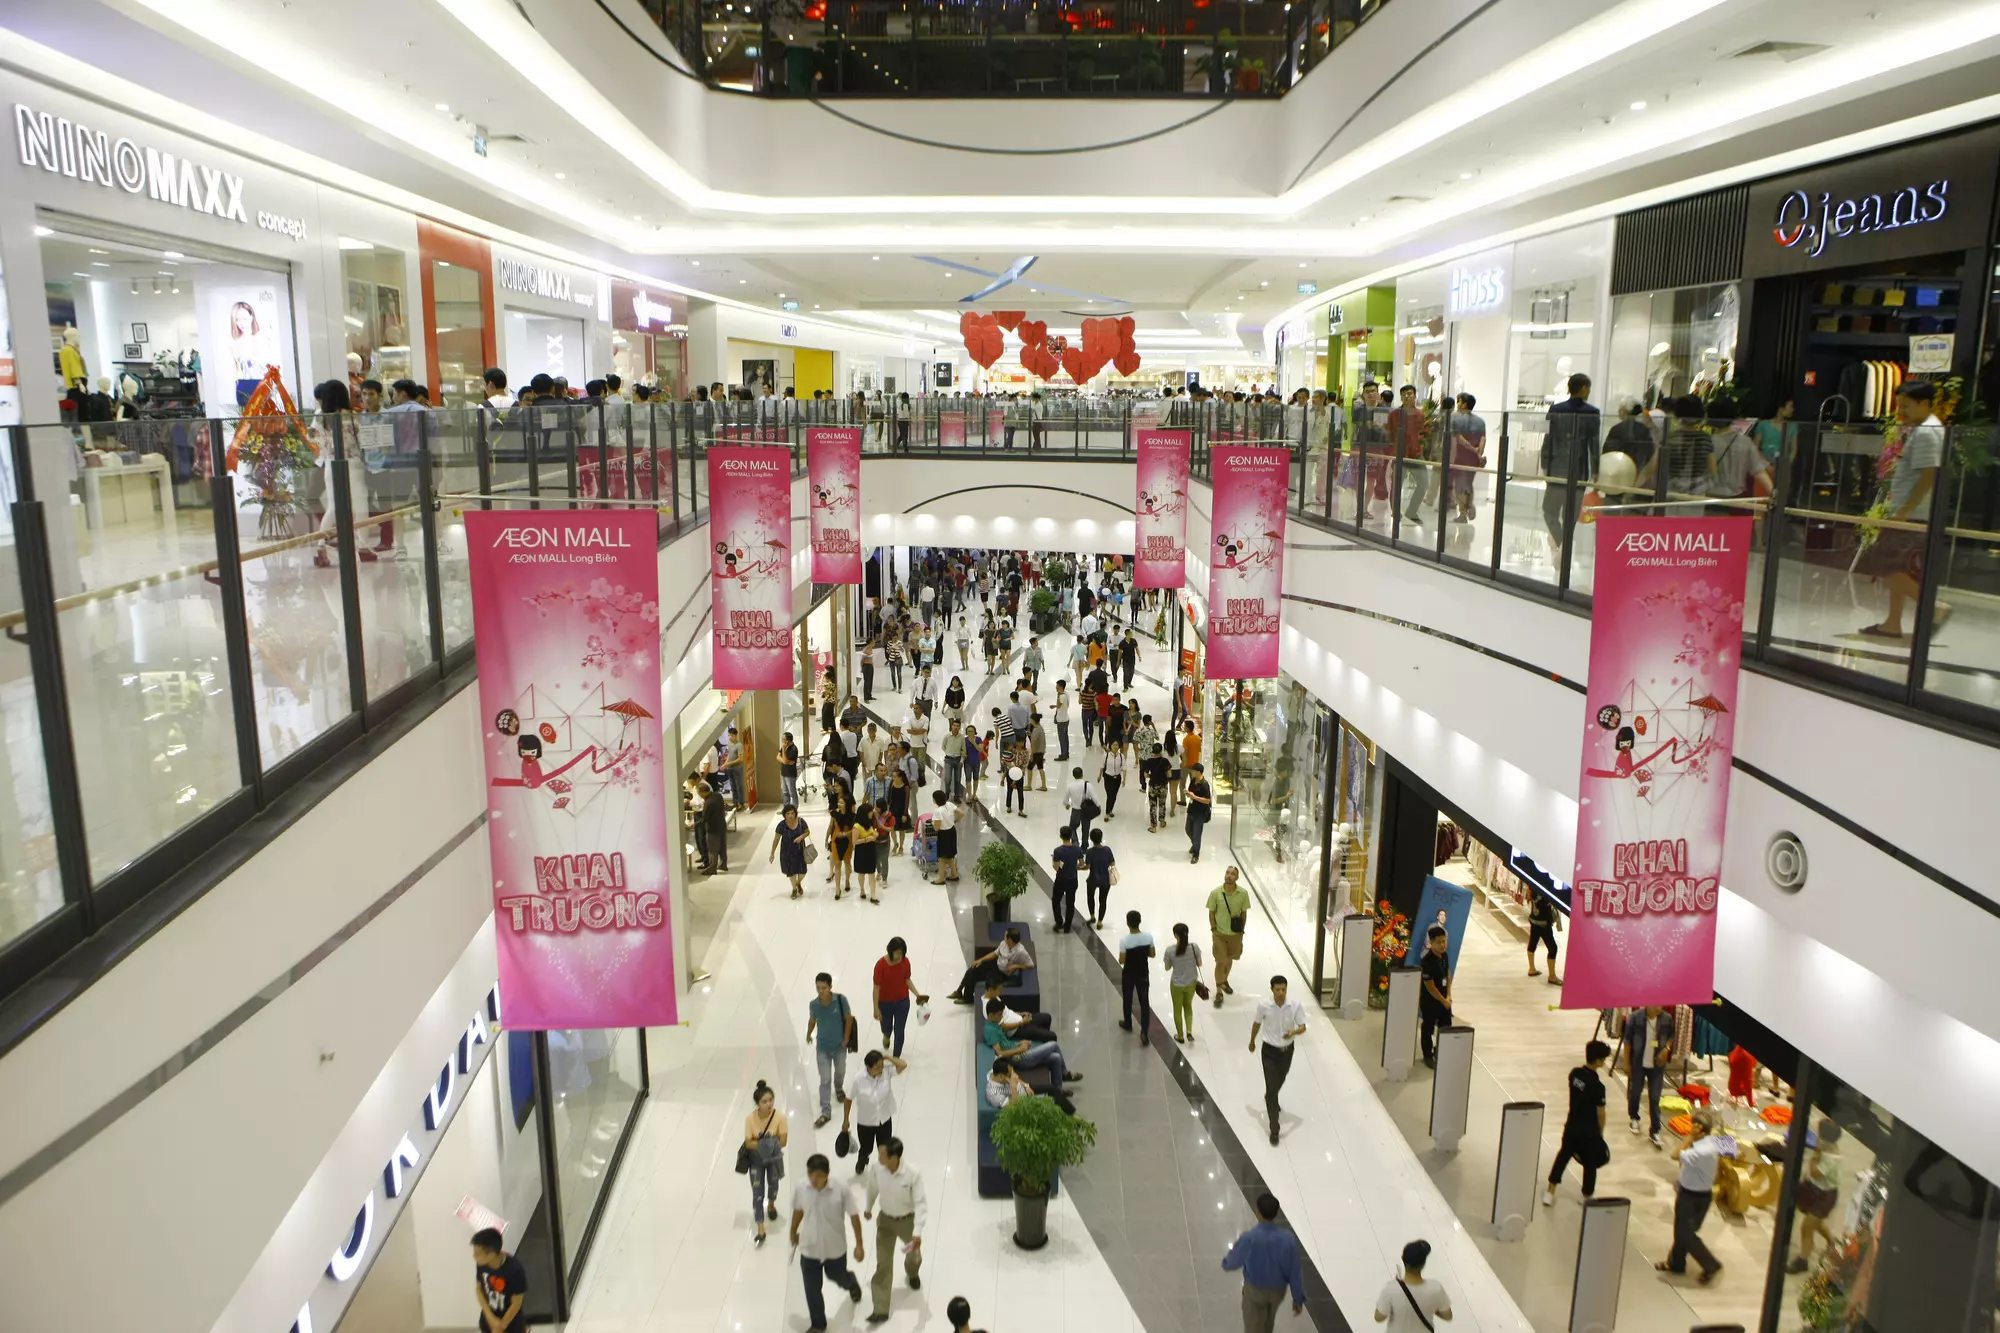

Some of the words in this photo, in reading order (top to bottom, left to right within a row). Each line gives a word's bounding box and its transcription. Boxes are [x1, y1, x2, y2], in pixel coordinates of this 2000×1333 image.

[15, 103, 248, 223] NINOMAXX
[256, 209, 308, 242] concept
[500, 258, 572, 303] NINOMAXX
[1164, 438, 1184, 446] MALL
[750, 460, 780, 471] MALL
[1253, 456, 1281, 466] MALL
[564, 527, 631, 548] MALL
[823, 528, 849, 541] KHAI
[1674, 532, 1731, 552] MALL
[538, 553, 567, 563] MALL
[569, 553, 594, 565] Long
[595, 553, 617, 563] Biên
[1651, 557, 1674, 567] MALL
[1676, 557, 1697, 568] Long
[1698, 557, 1718, 567] Biên
[1227, 598, 1264, 616] KHAI
[731, 610, 772, 629] KHAI
[1614, 838, 1687, 878] KHAI
[533, 852, 626, 893] KHAI
[1432, 886, 1462, 907] F&F
